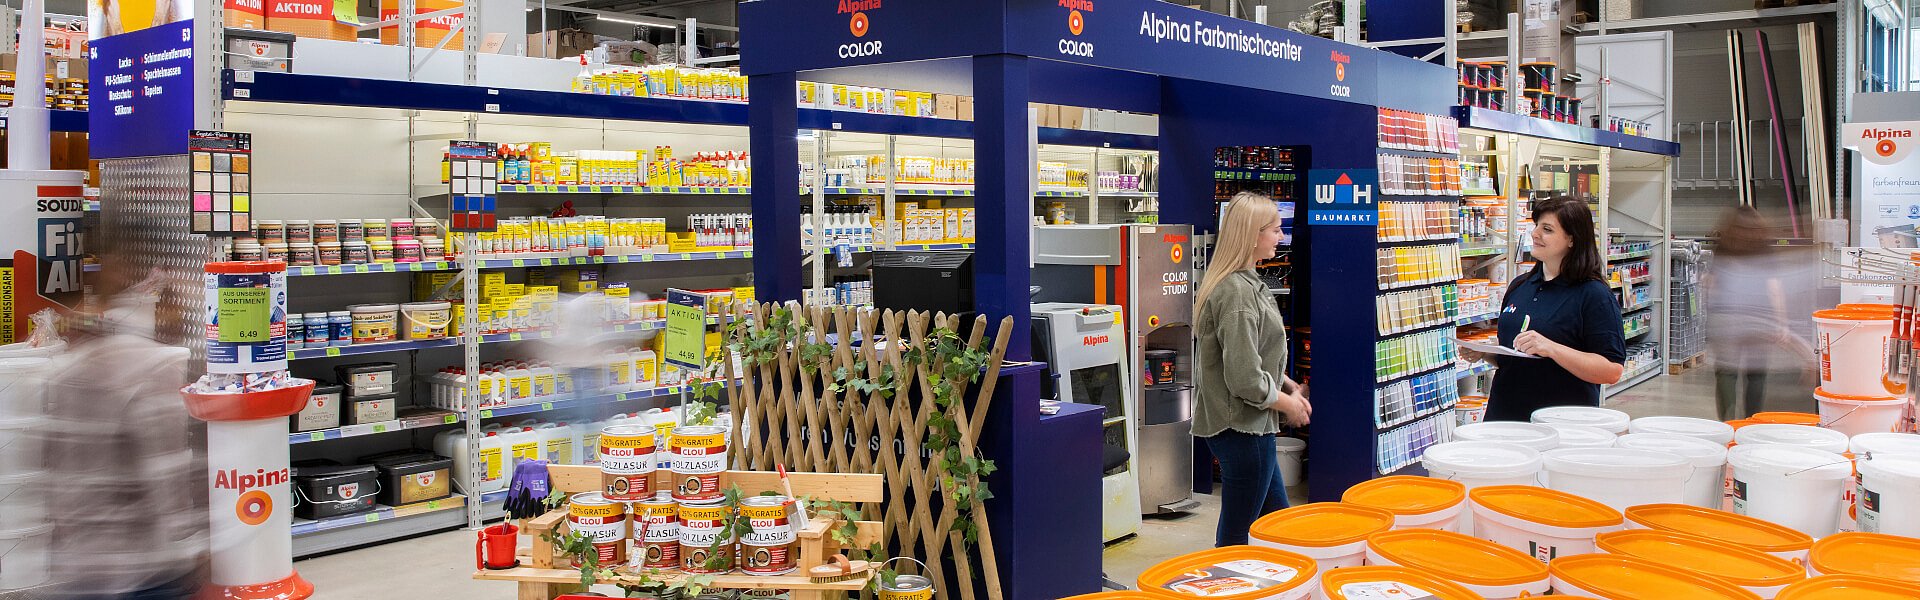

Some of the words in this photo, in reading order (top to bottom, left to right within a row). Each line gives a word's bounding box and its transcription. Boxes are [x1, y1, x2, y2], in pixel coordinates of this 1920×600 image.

[235, 0, 262, 10] AKTION
[275, 2, 322, 14] AKTION
[837, 0, 881, 16] Alpina
[182, 28, 190, 42] 53
[1140, 11, 1191, 43] Alpina
[1195, 21, 1302, 62] Farbmischcenter
[90, 47, 98, 60] 54
[838, 41, 882, 58] COLOR
[1058, 39, 1094, 58] COLOR
[1330, 50, 1350, 64] Alpina
[1330, 84, 1350, 97] COLOR
[1861, 128, 1912, 141] Alpina
[1162, 272, 1188, 282] COLOR
[2, 270, 12, 320] EMISSIONSARM
[1162, 284, 1188, 296] STUDIO
[672, 309, 701, 320] AKTION
[4, 322, 12, 344] SEHR
[1084, 334, 1108, 346] Alpina
[678, 350, 694, 360] 44,99
[214, 468, 288, 496] Alpina
[634, 528, 680, 538] HOZLASUR
